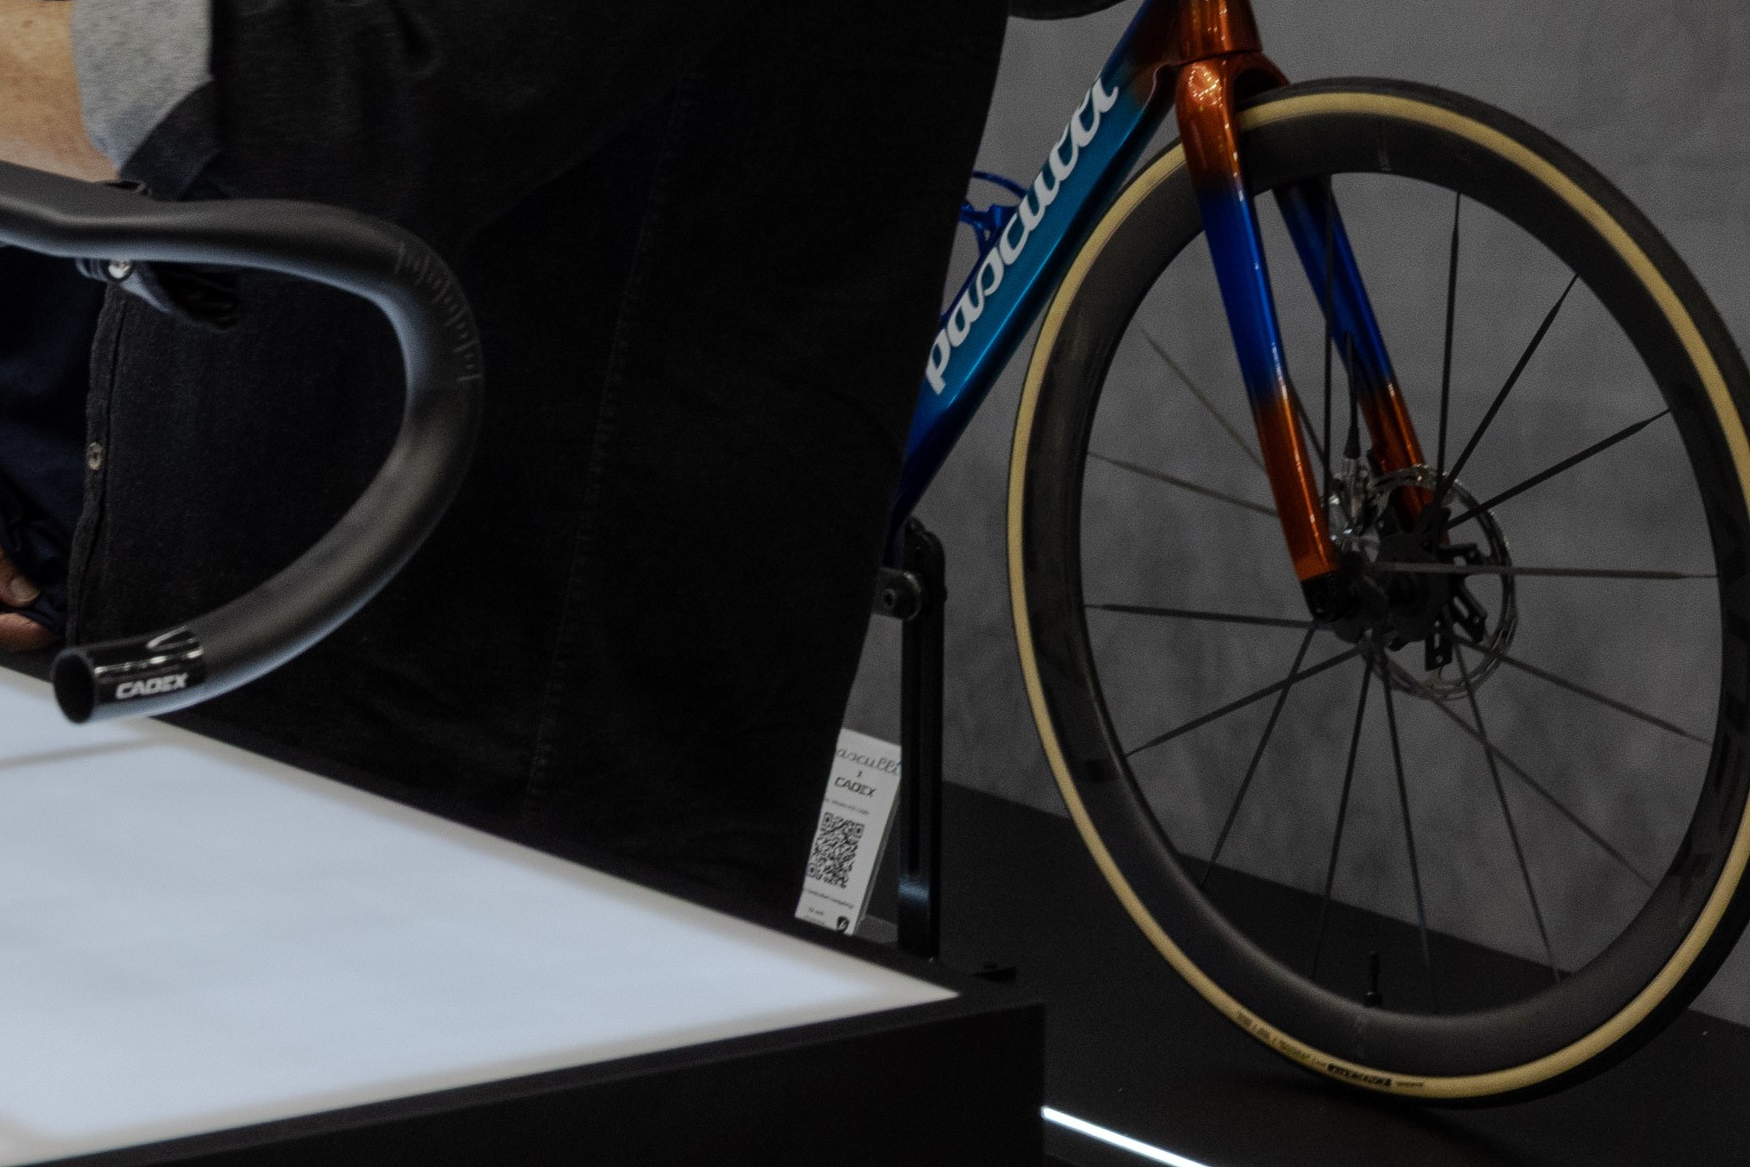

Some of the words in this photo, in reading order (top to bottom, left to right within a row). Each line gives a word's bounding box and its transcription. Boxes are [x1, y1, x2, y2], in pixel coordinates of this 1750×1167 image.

[116, 673, 189, 700] CADEX
[836, 748, 902, 776] asculli
[834, 776, 876, 798] CADEX
